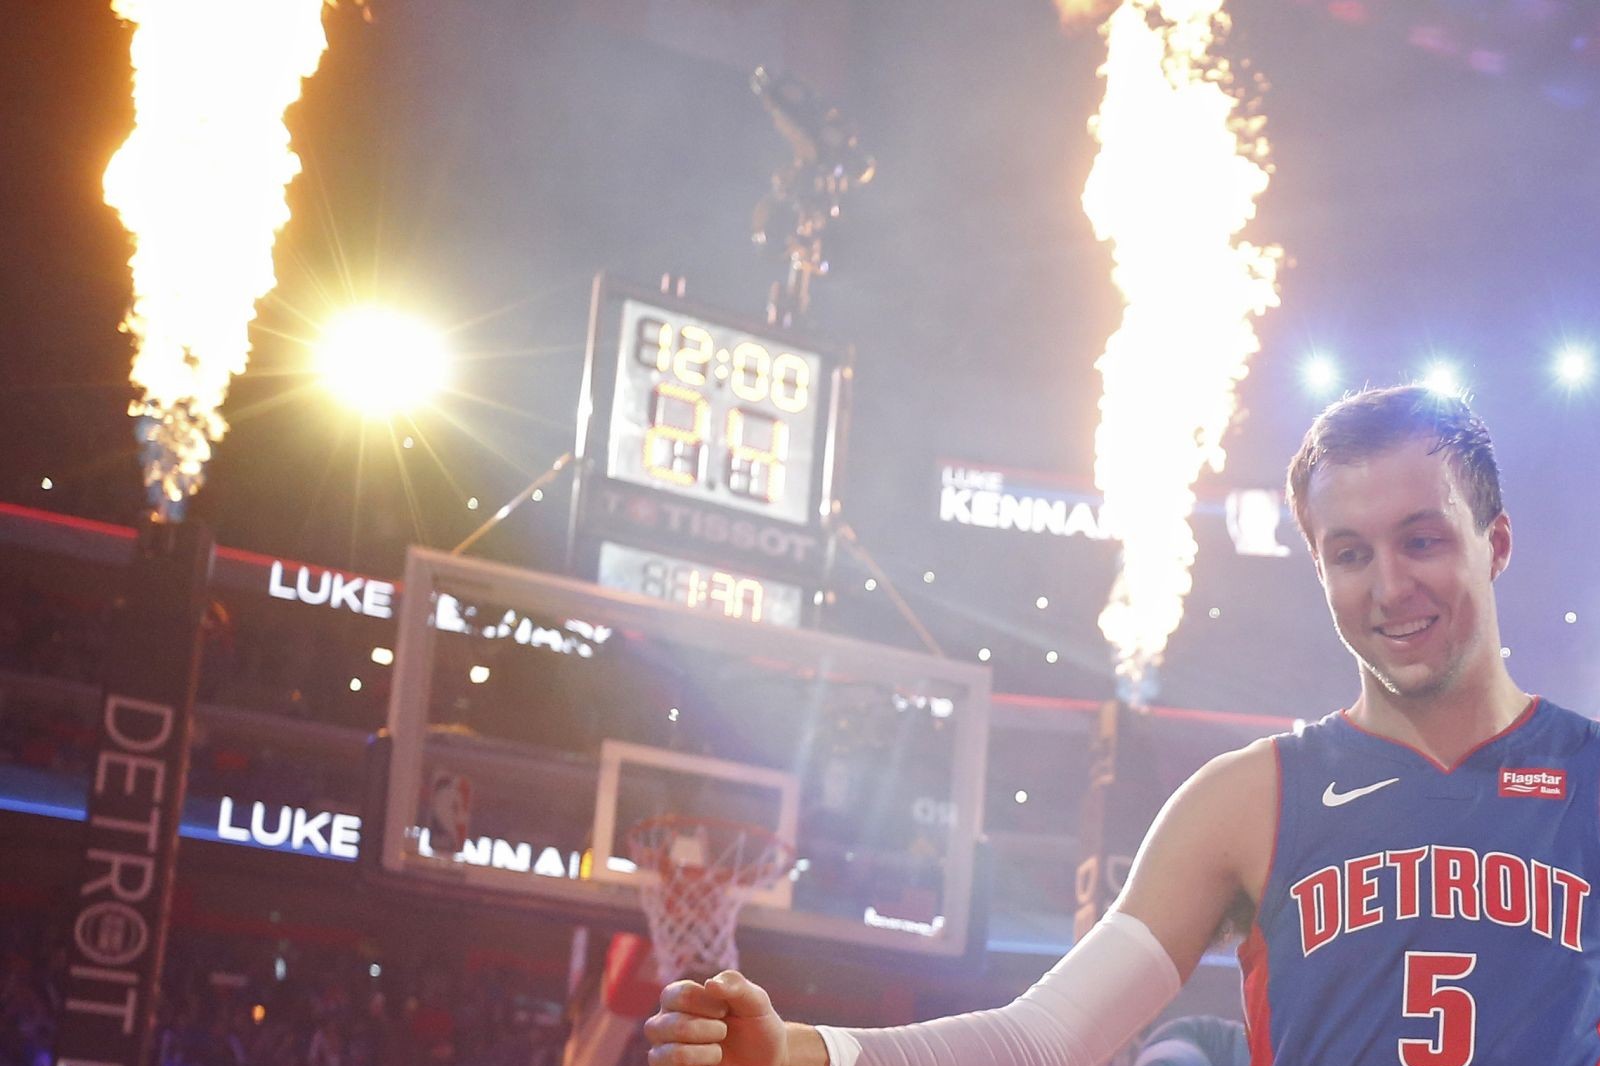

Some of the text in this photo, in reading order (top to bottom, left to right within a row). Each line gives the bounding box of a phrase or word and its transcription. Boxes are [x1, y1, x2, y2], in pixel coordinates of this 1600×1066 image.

[655, 322, 810, 413] 12:00
[643, 382, 789, 502] 24
[941, 466, 1004, 492] LUKE
[663, 504, 818, 562] TISSOT
[940, 486, 1112, 540] KENNA
[269, 560, 395, 619] LUKE
[1503, 772, 1562, 785] Flagstar
[1540, 786, 1561, 794] Bank
[217, 796, 362, 859] LUKE
[65, 693, 174, 1036] DETROIT
[1290, 845, 1591, 957] DETROIT
